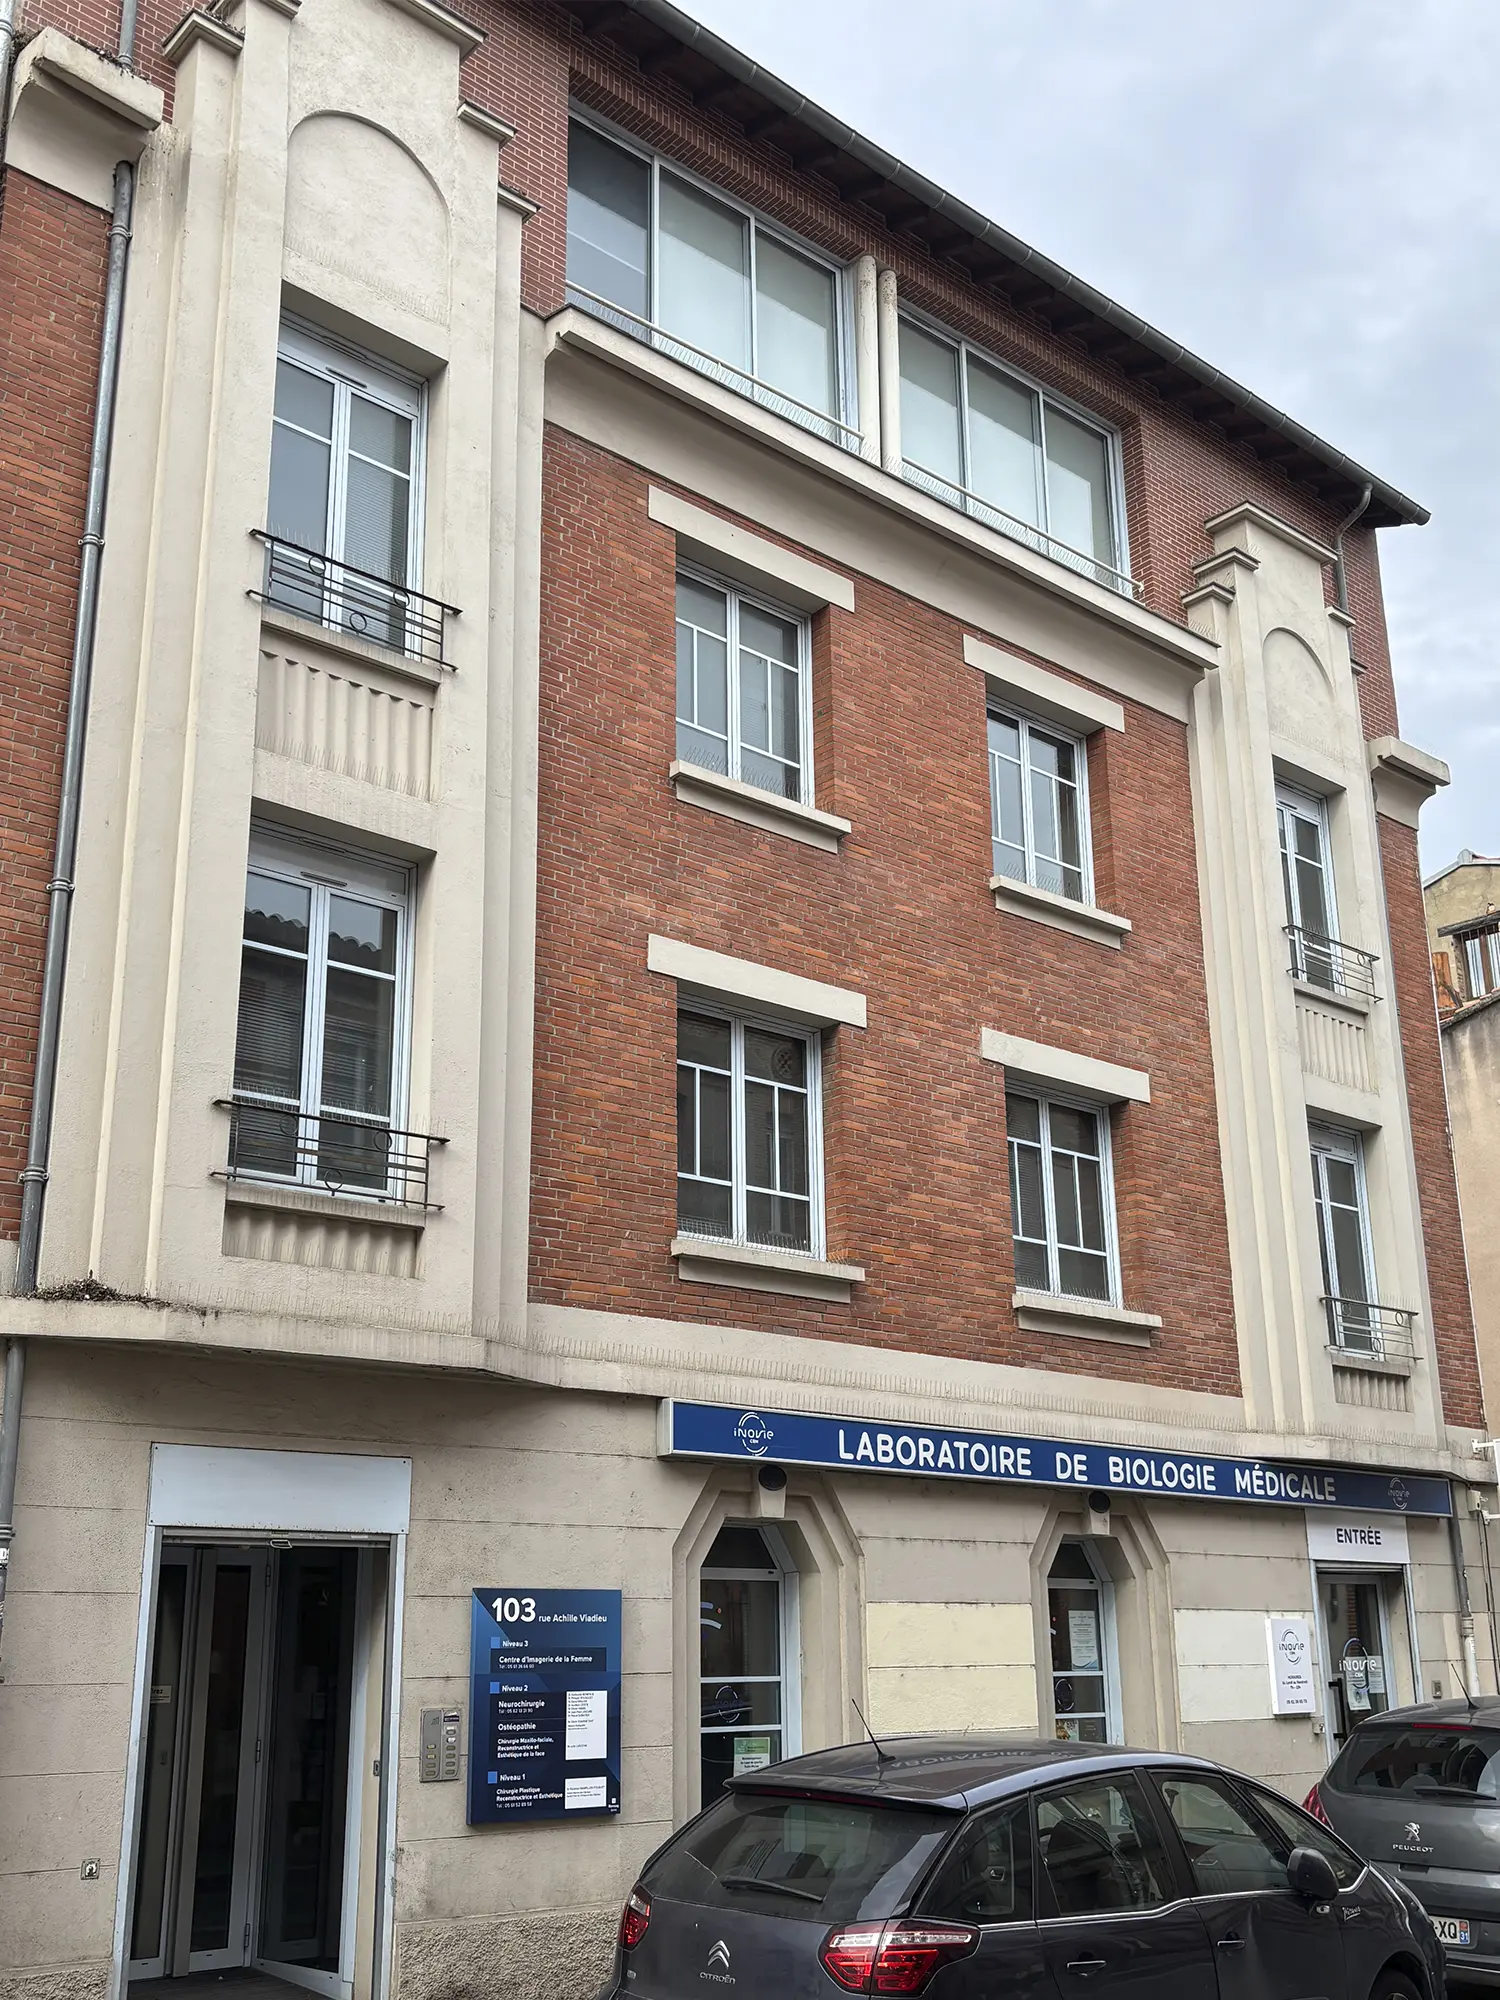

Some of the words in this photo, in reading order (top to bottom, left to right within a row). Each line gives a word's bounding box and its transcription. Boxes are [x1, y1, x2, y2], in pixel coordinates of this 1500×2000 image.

[838, 1429, 1032, 1476] LABORATOIRE
[1055, 1452, 1088, 1482] DE
[1108, 1456, 1216, 1491] BIOLOGIE
[1234, 1463, 1337, 1501] MÉDICALE
[1336, 1525, 1382, 1546] ENTRÉE
[491, 1597, 536, 1623] 103
[538, 1615, 551, 1623] rue
[553, 1613, 578, 1623] Achille
[579, 1613, 607, 1623] Viadieu
[499, 1655, 521, 1664] Centre
[554, 1655, 563, 1663] de
[563, 1655, 570, 1663] la
[570, 1655, 593, 1663] Femme
[498, 1700, 546, 1709] Neurochirurgie
[497, 1722, 537, 1731] Ostéopathie
[500, 1773, 522, 1781] Niveau
[496, 1788, 518, 1796] Chirurgie
[496, 1794, 533, 1802] Reconstructrice
[539, 1791, 563, 1800] Esthétique
[1392, 1843, 1434, 1853] PEUGEOT
[1460, 1931, 1468, 1941] 31
[699, 1971, 736, 1985] CITROËN
